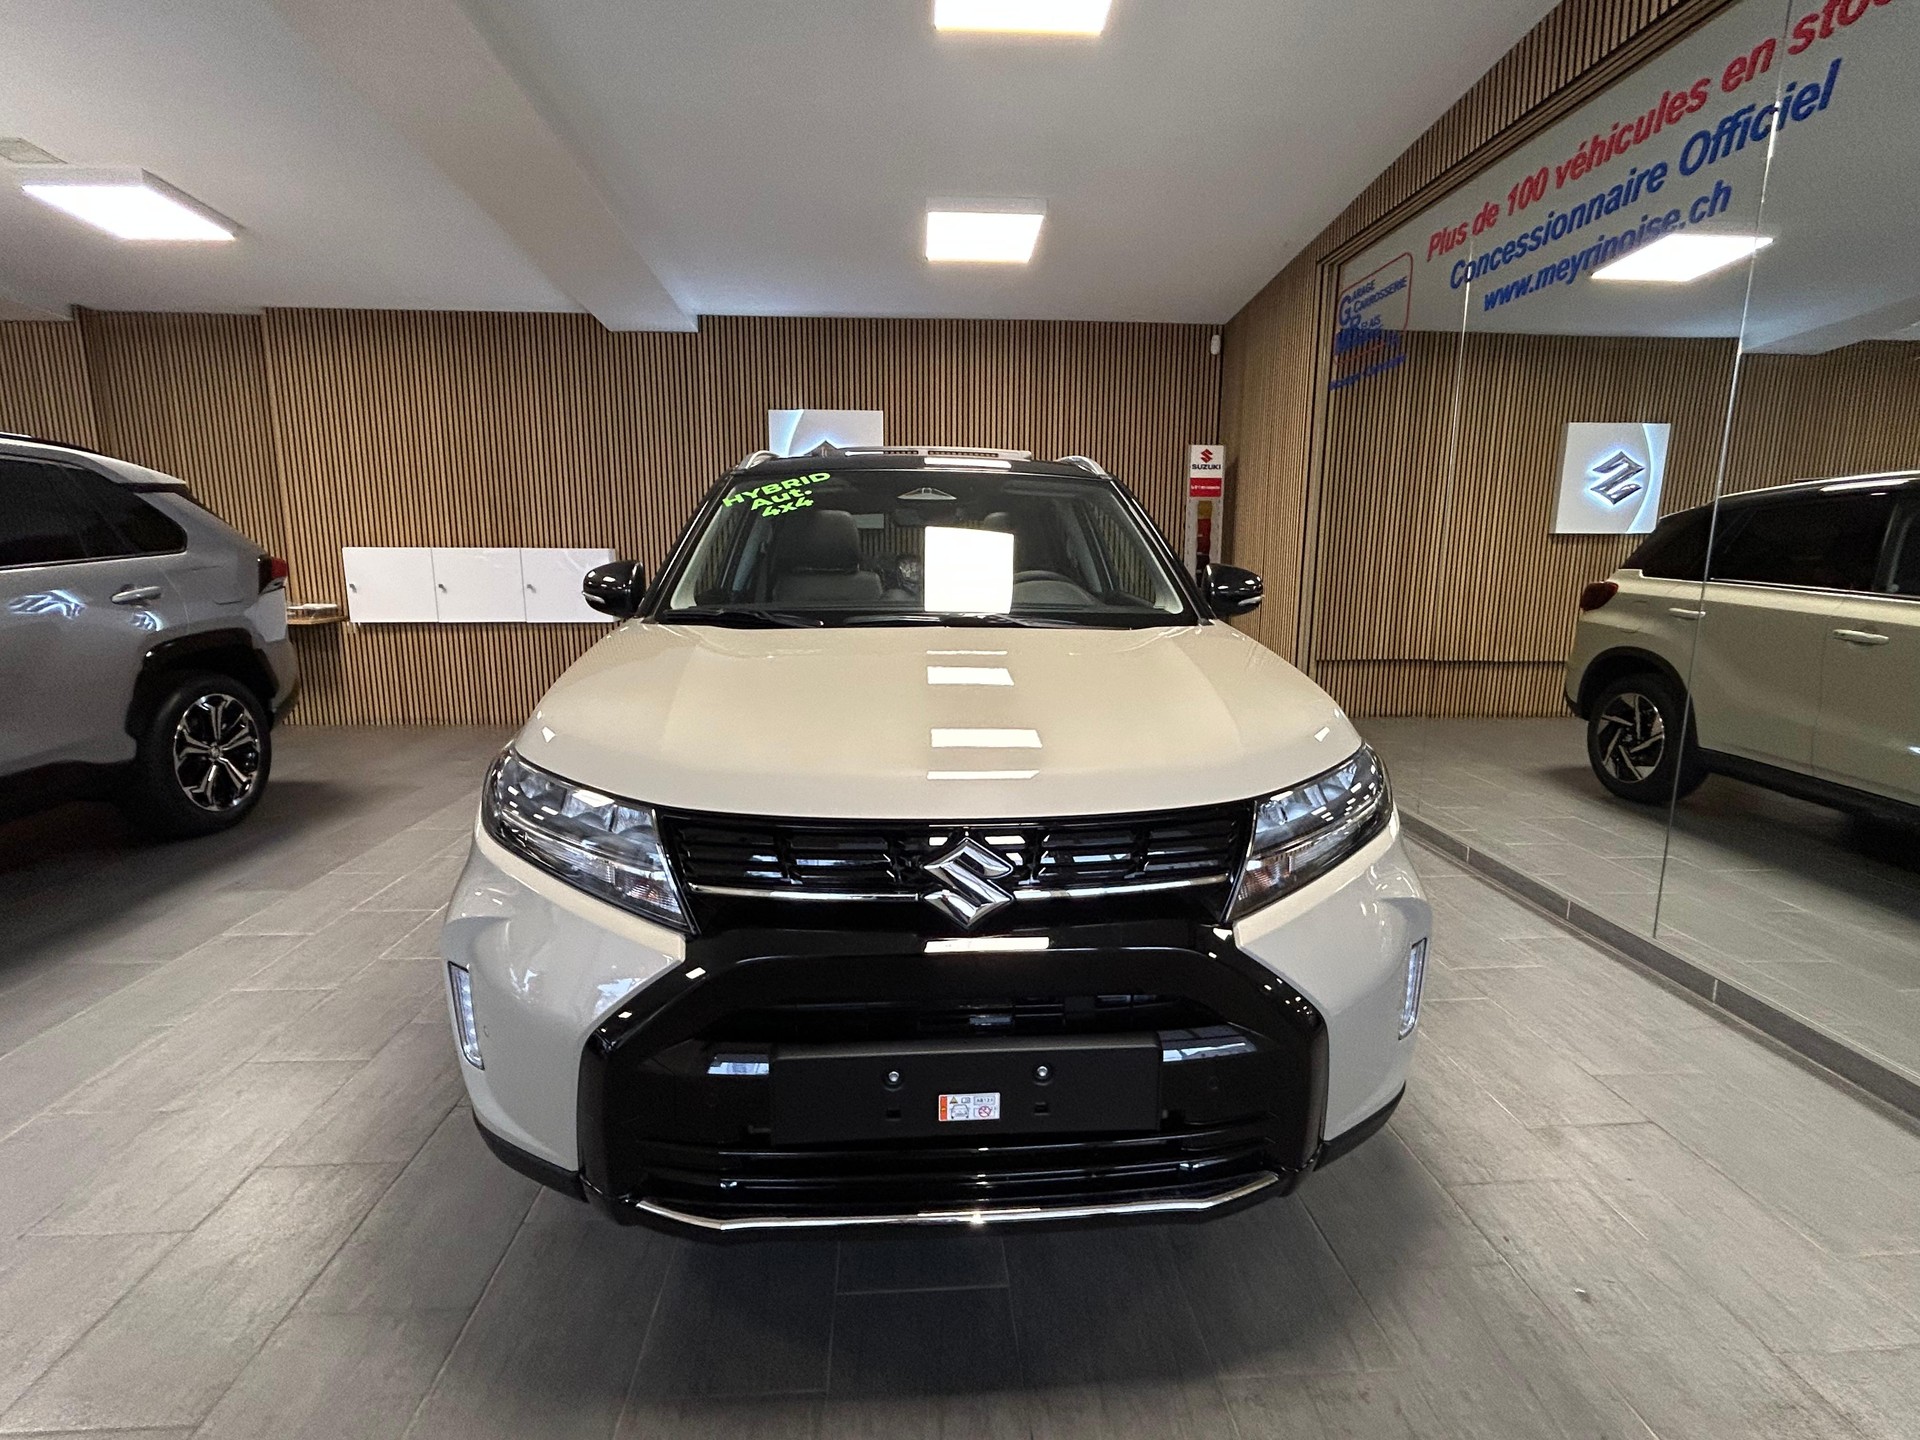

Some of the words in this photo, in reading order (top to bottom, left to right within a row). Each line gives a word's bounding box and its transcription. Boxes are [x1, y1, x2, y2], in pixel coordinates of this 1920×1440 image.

[1426, 222, 1469, 262] Plus
[1471, 202, 1500, 236] de
[1507, 166, 1549, 217] 100
[1555, 78, 1711, 189] véhicules
[1721, 38, 1777, 93] en
[1787, 0, 1892, 55] sto
[1450, 161, 1668, 289] Concessionnaire
[1679, 57, 1843, 176] Officiel
[1484, 179, 1733, 311] www.meyrinoise.ch
[722, 472, 831, 507] HYBRID
[751, 488, 812, 510] Aut.
[762, 496, 814, 517] 4x4
